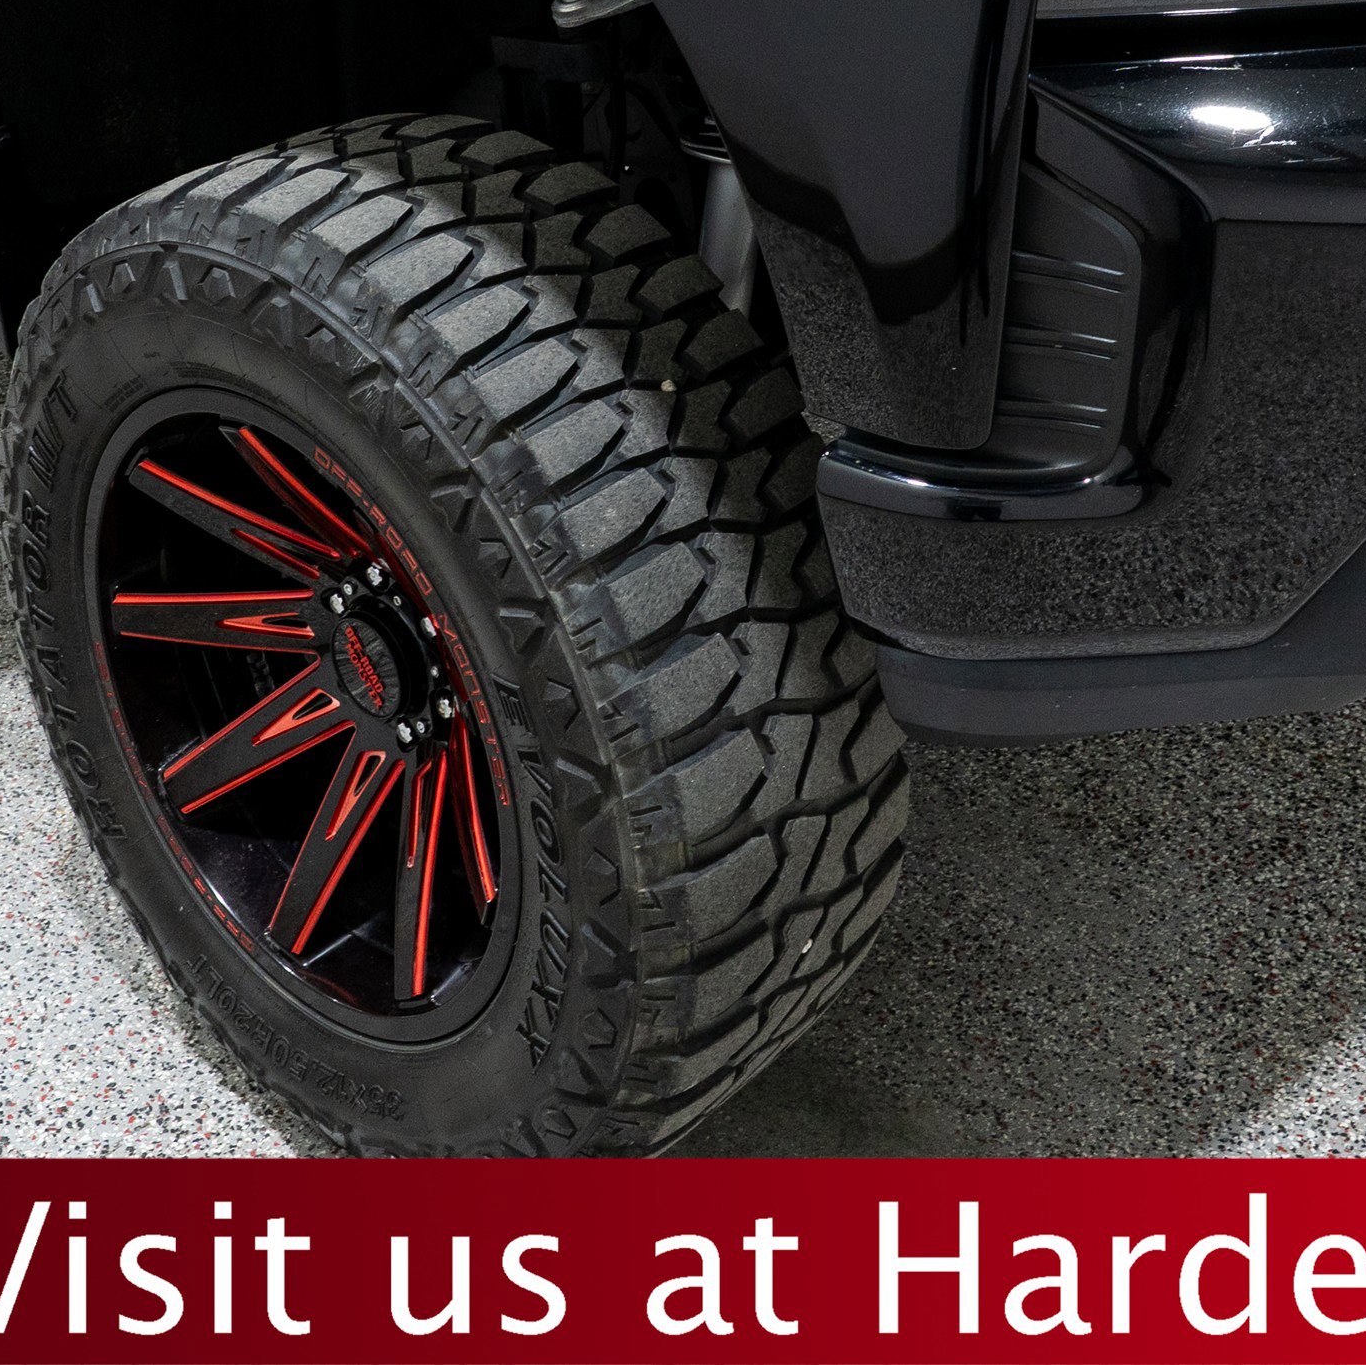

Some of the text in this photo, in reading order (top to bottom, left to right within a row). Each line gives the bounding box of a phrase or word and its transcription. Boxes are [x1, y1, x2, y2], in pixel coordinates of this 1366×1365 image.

[313, 445, 511, 807] OFF-ROAD MONSTER
[345, 625, 384, 694] OFF-ROAD
